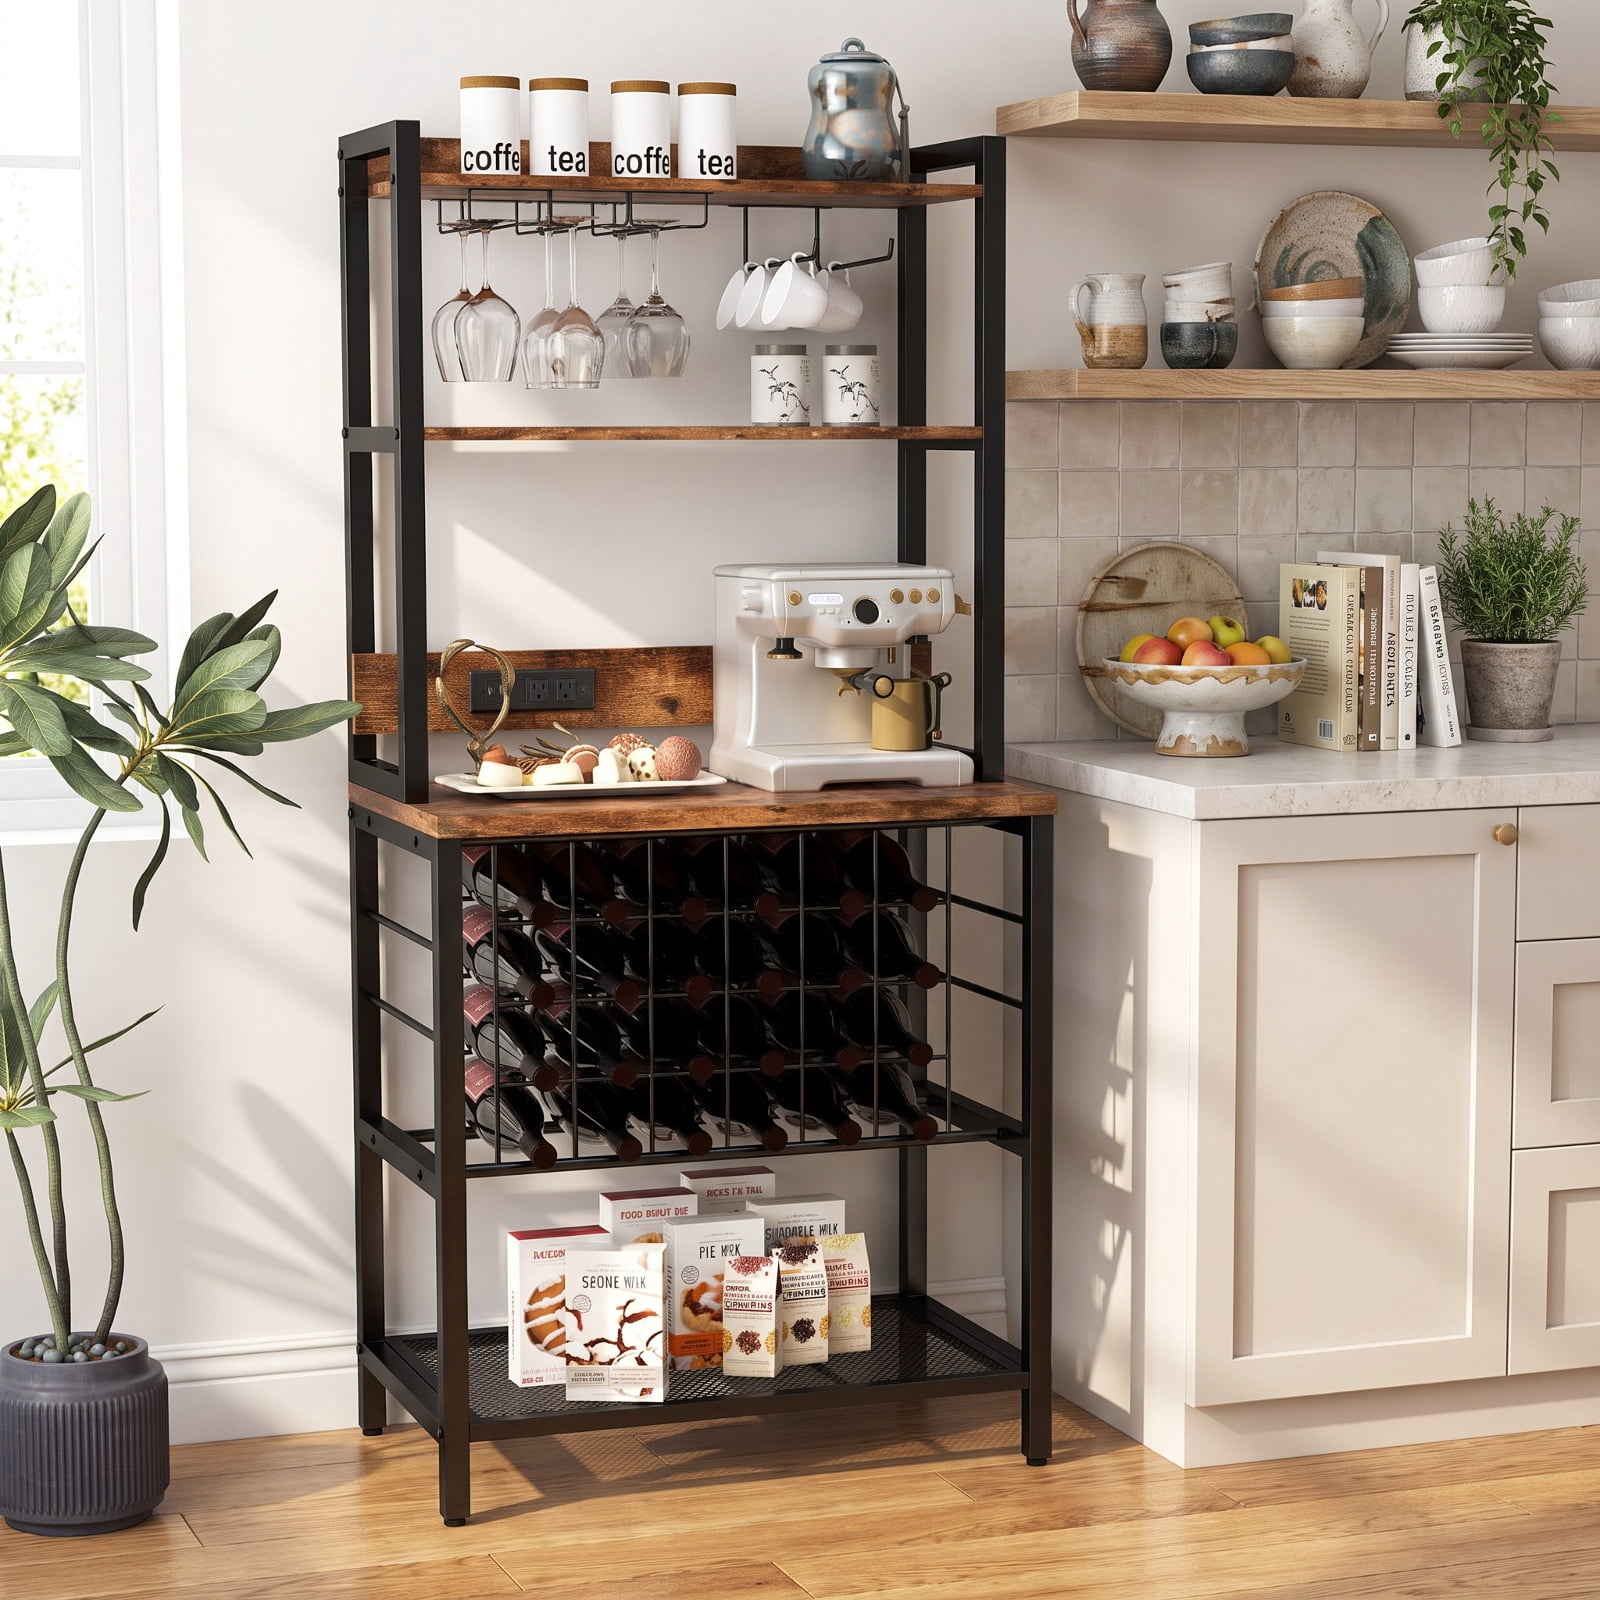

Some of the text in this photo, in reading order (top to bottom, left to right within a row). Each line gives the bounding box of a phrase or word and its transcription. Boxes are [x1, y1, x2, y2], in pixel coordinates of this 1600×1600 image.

[548, 145, 586, 173] tea
[698, 149, 734, 177] tea
[620, 1209, 643, 1220] FOOD
[674, 1206, 689, 1216] DUE
[699, 1245, 716, 1259] PIE
